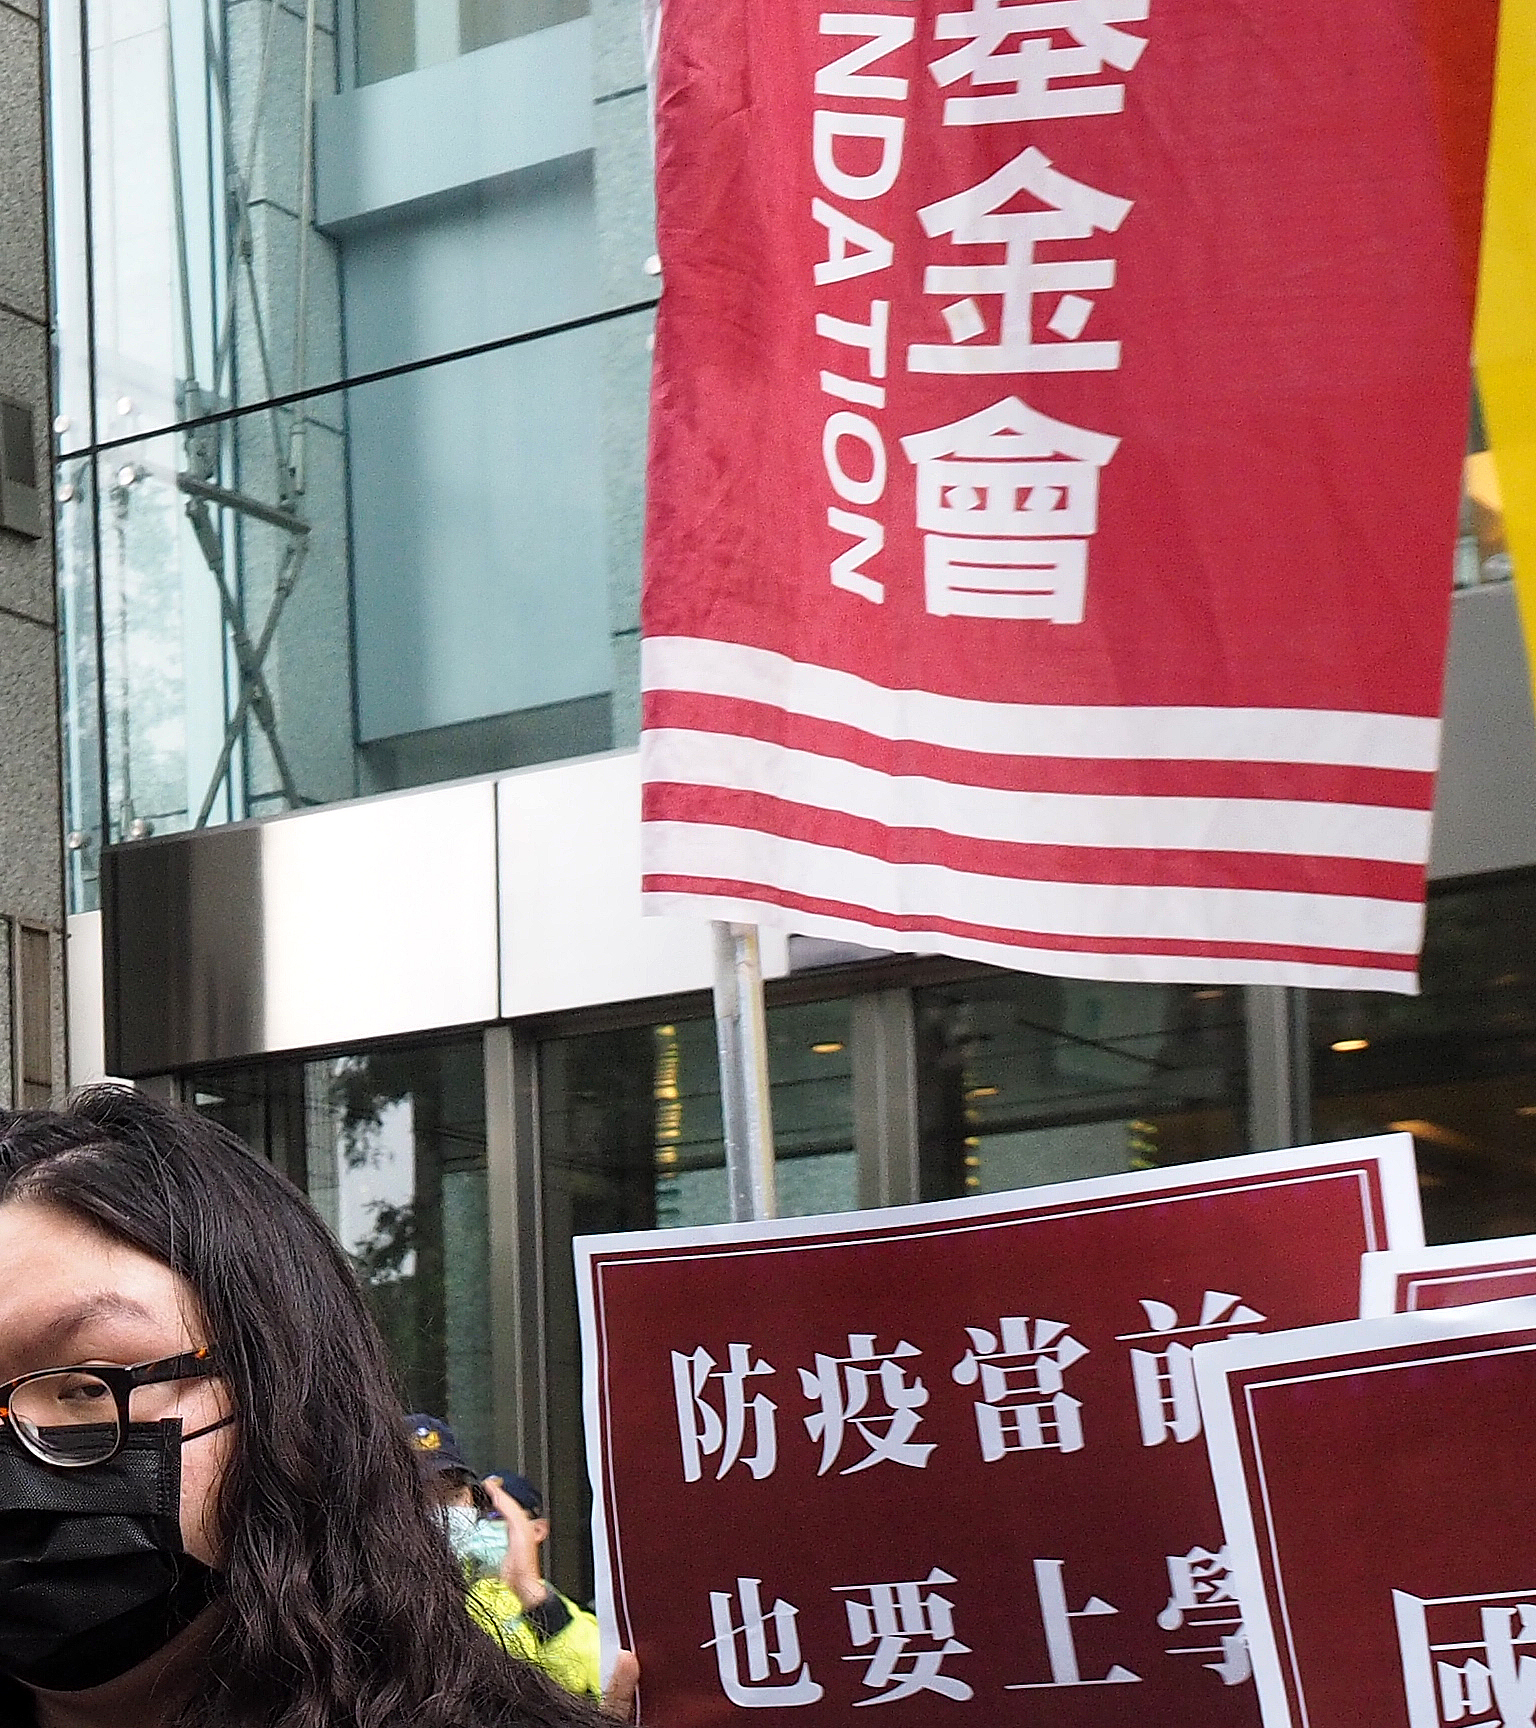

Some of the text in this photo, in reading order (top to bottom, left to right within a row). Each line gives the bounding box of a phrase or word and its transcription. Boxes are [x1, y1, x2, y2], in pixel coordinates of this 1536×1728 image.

[813, 13, 917, 605] NDATION
[900, 0, 1148, 625] 基金會
[671, 1290, 1267, 1483] 防疫當前
